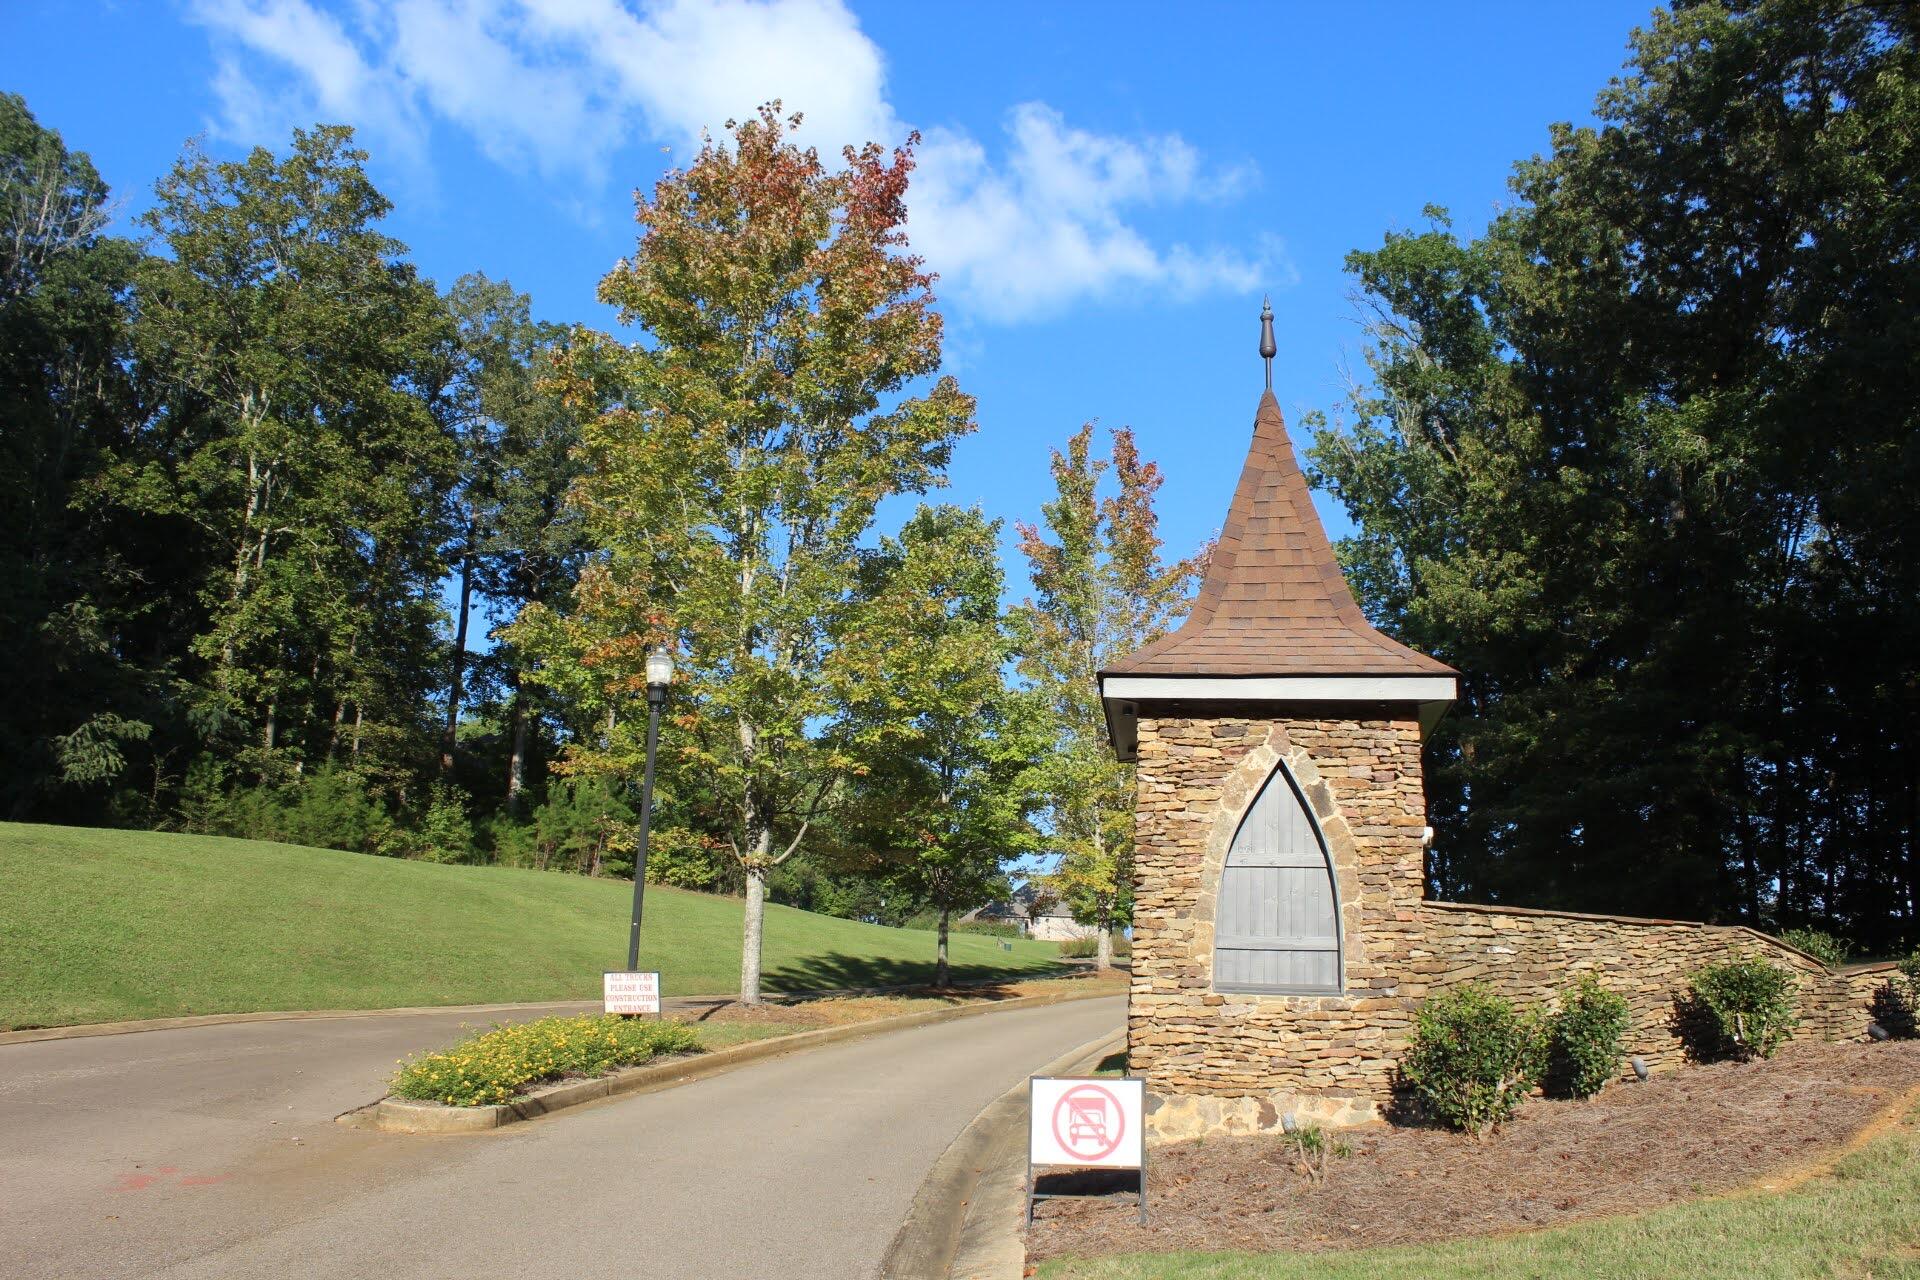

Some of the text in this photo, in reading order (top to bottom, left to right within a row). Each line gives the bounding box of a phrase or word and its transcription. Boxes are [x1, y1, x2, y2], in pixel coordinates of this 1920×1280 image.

[610, 973, 623, 981] ALL
[610, 984, 653, 992] PLEASE USE
[605, 994, 658, 1002] CONSTRUCTION
[613, 1004, 652, 1012] ENTRANCE
